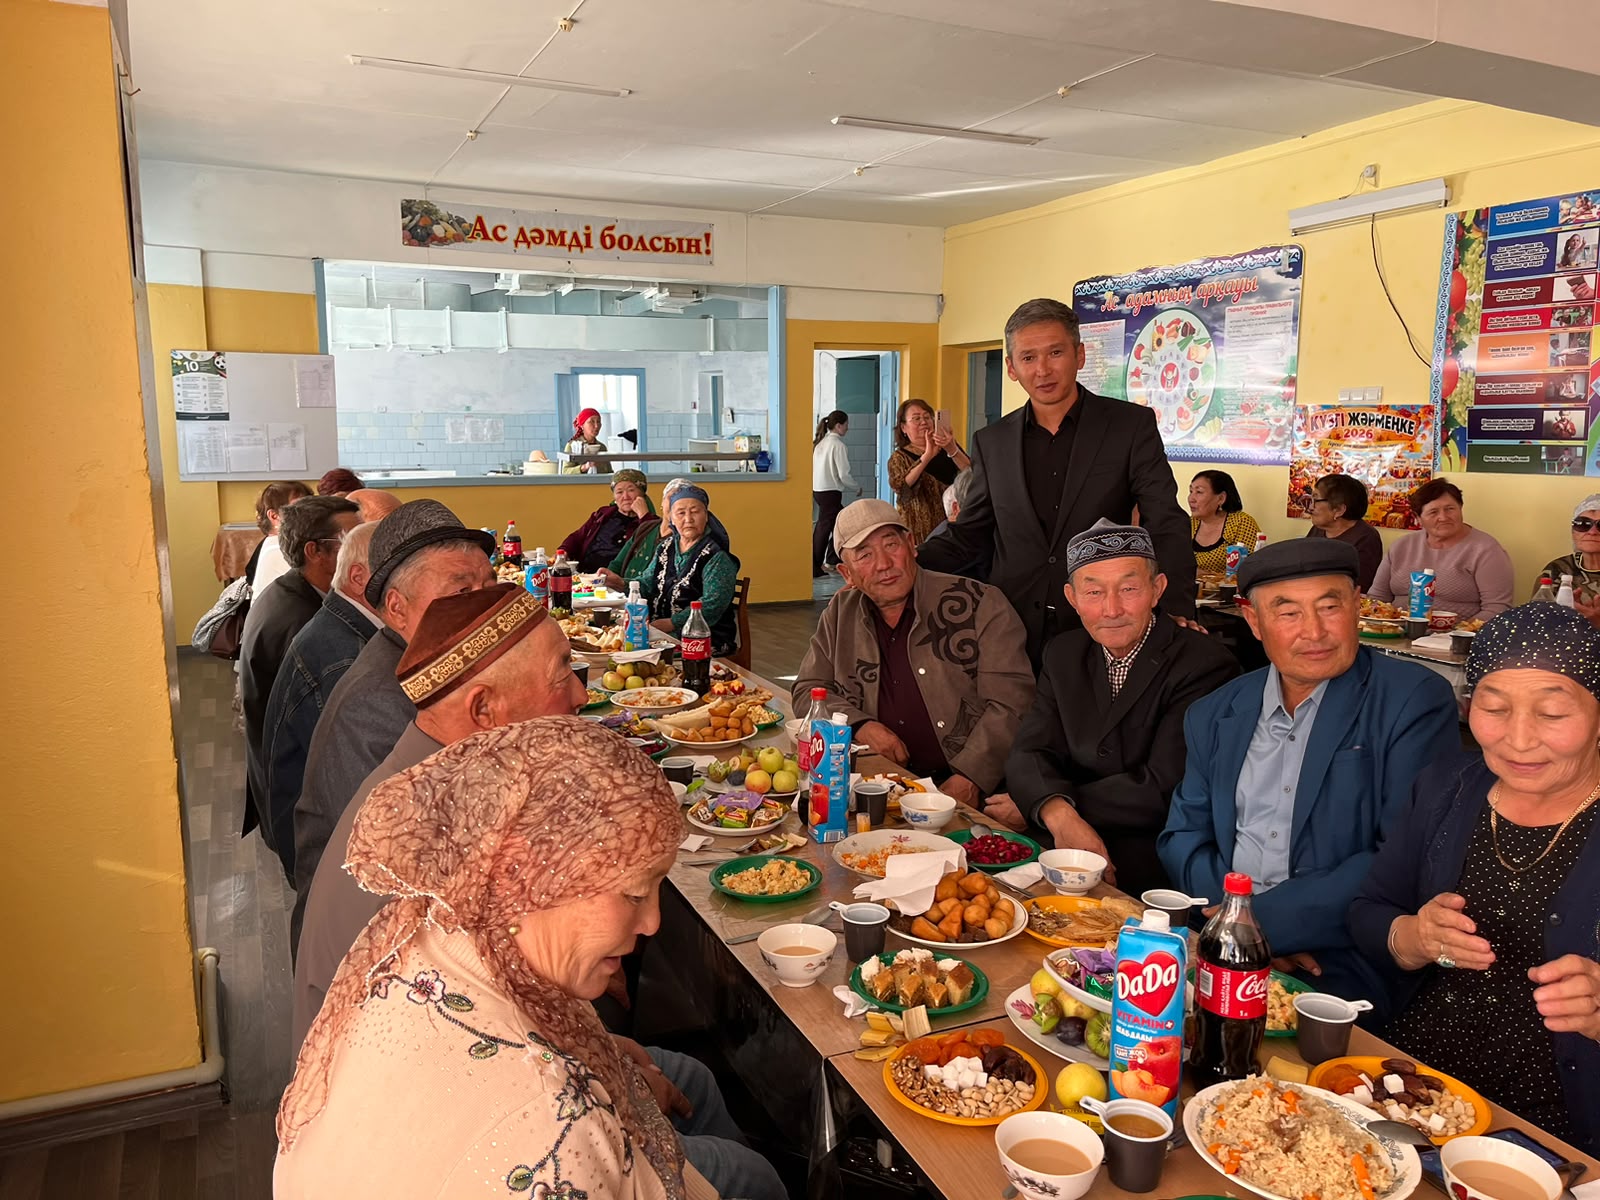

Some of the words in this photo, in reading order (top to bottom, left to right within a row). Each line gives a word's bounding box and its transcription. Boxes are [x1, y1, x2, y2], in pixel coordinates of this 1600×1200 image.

[467, 214, 509, 243] Ас
[513, 224, 594, 255] дәмді
[599, 224, 713, 256] болсын!
[1101, 291, 1120, 312] Ас
[1125, 284, 1193, 317] адамның
[1195, 275, 1259, 308] арқауы
[183, 361, 199, 372] 10
[1310, 412, 1345, 432] КҮЗГІ
[1347, 412, 1416, 436] ЖӘРМЕҢКЕ
[1344, 428, 1373, 440] 2026
[1116, 962, 1177, 1000] DaDa
